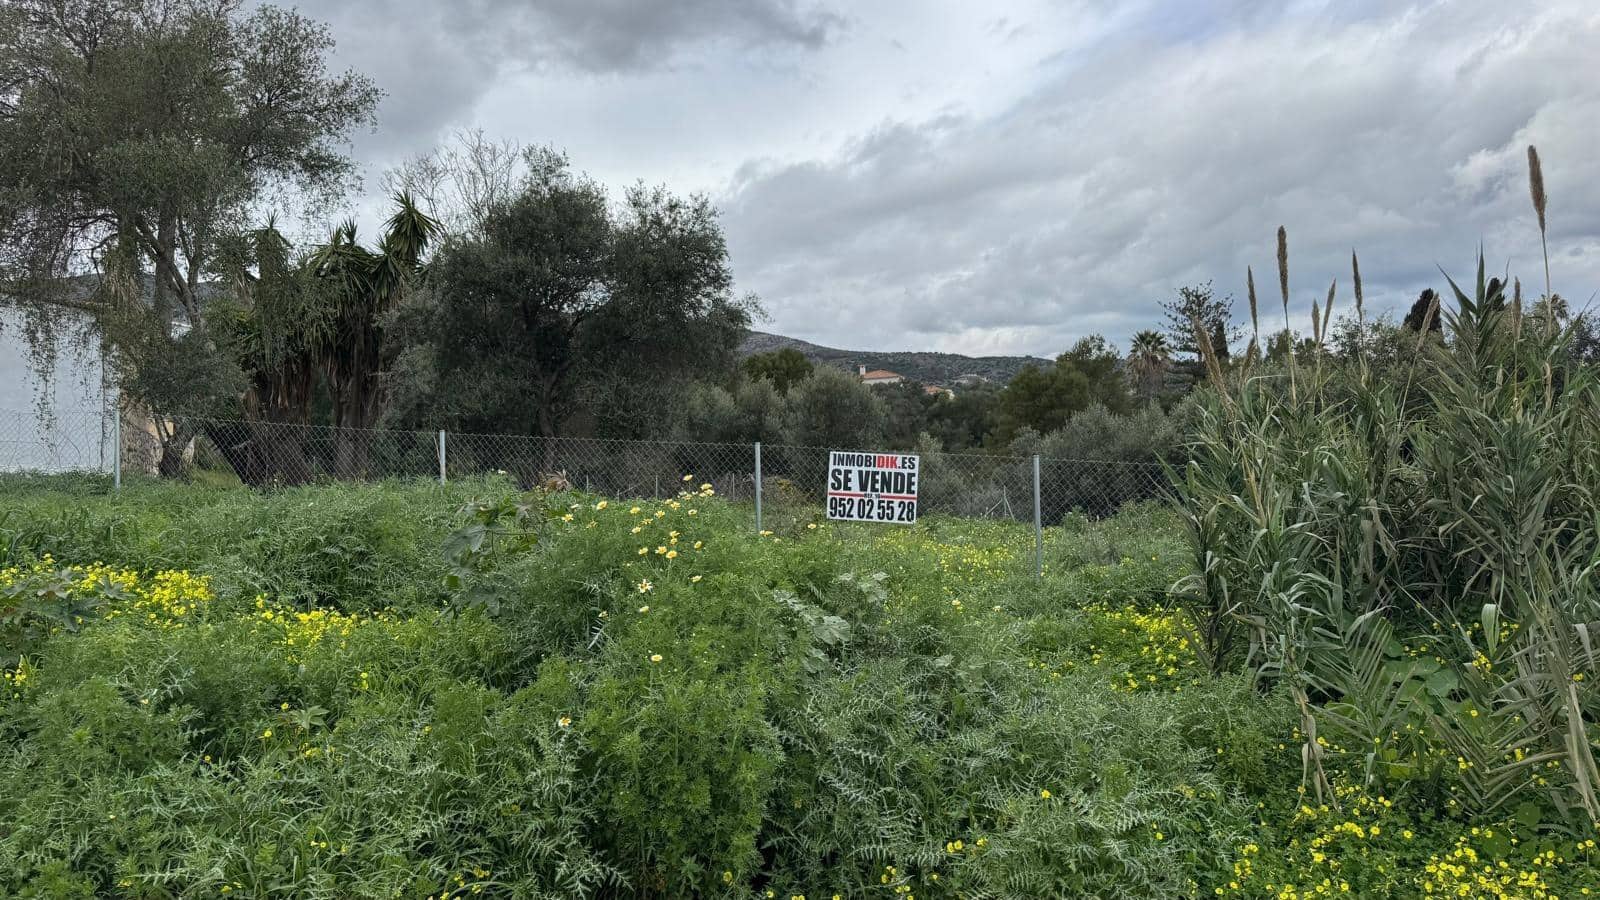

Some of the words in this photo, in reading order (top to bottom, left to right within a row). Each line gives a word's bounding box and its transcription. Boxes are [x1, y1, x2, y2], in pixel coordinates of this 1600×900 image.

[833, 453, 916, 470] INMOBIDIK.ES
[831, 469, 852, 491] SE
[858, 470, 916, 495] VENDE
[829, 497, 854, 518] 952
[857, 499, 875, 519] 02
[877, 500, 895, 520] 55
[898, 501, 915, 522] 28
